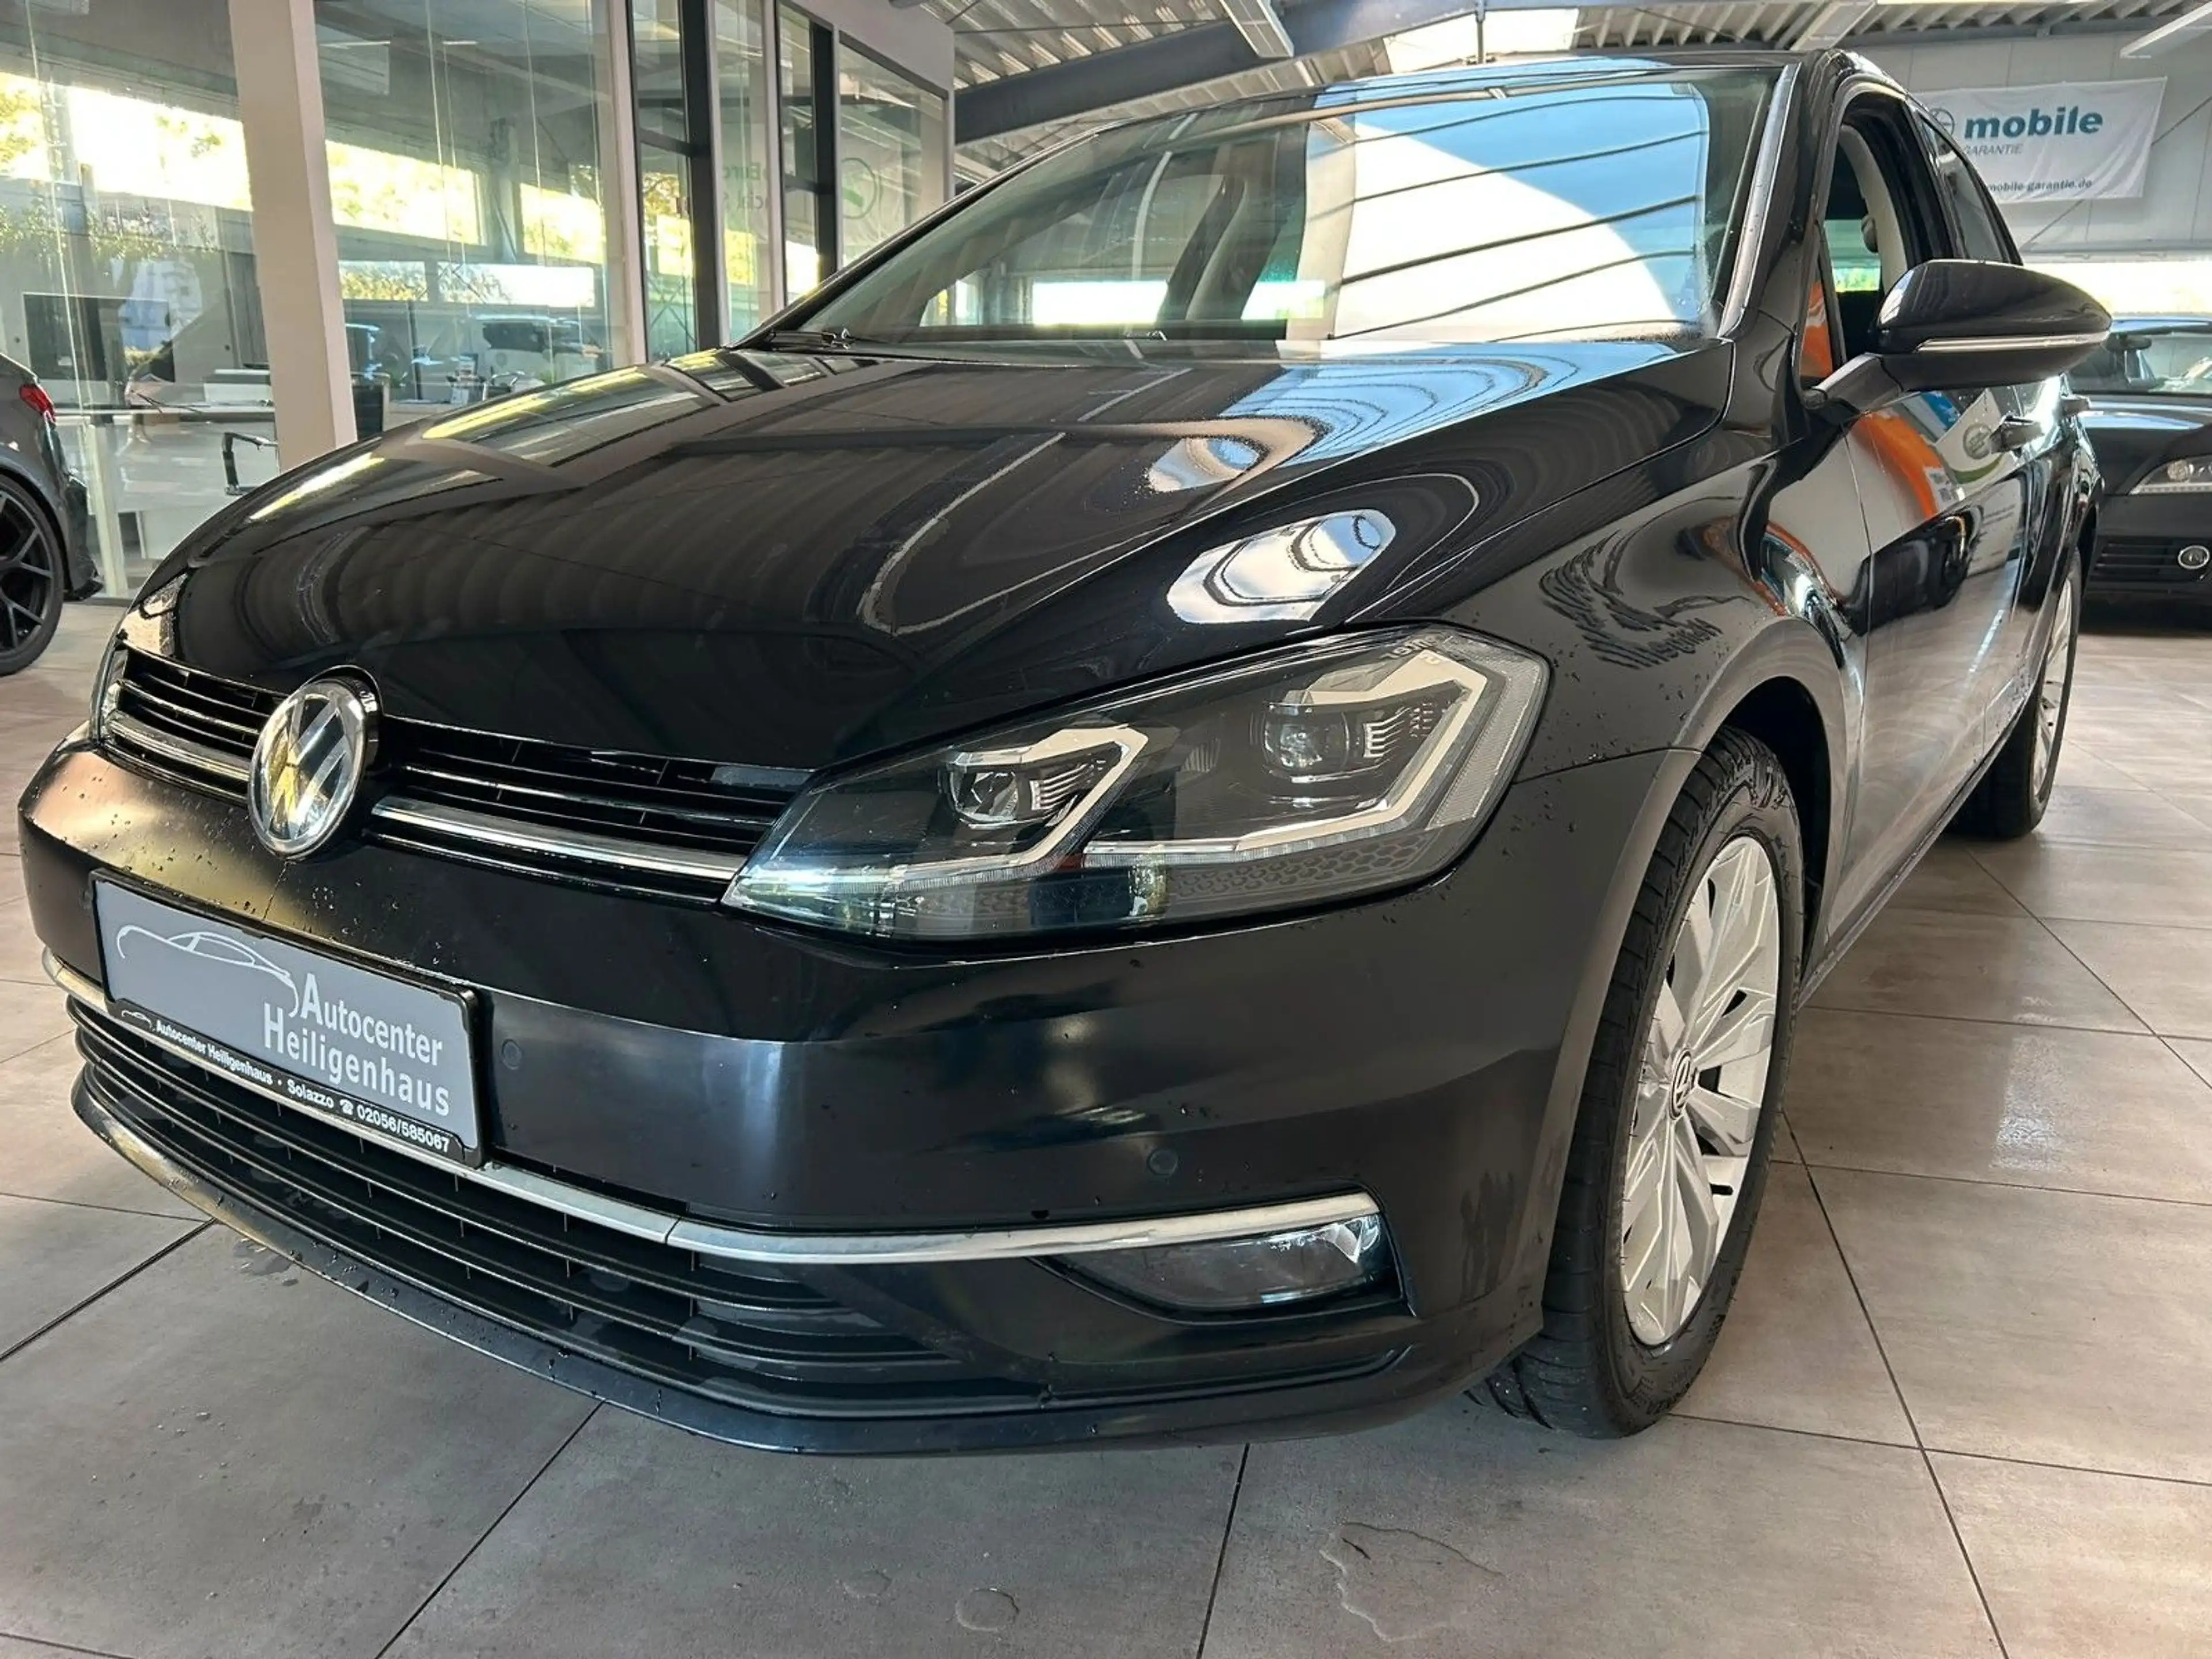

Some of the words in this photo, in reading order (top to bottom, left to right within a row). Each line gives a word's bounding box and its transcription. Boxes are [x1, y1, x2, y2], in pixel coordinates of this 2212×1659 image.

[1964, 105, 2104, 139] mobile
[155, 1018, 208, 1055] Autocenter
[207, 1042, 273, 1086] Heiligenhaus
[287, 1078, 334, 1108] Solazzo
[263, 1002, 449, 1116] Heiligenhaus
[300, 972, 443, 1066] Autocenter
